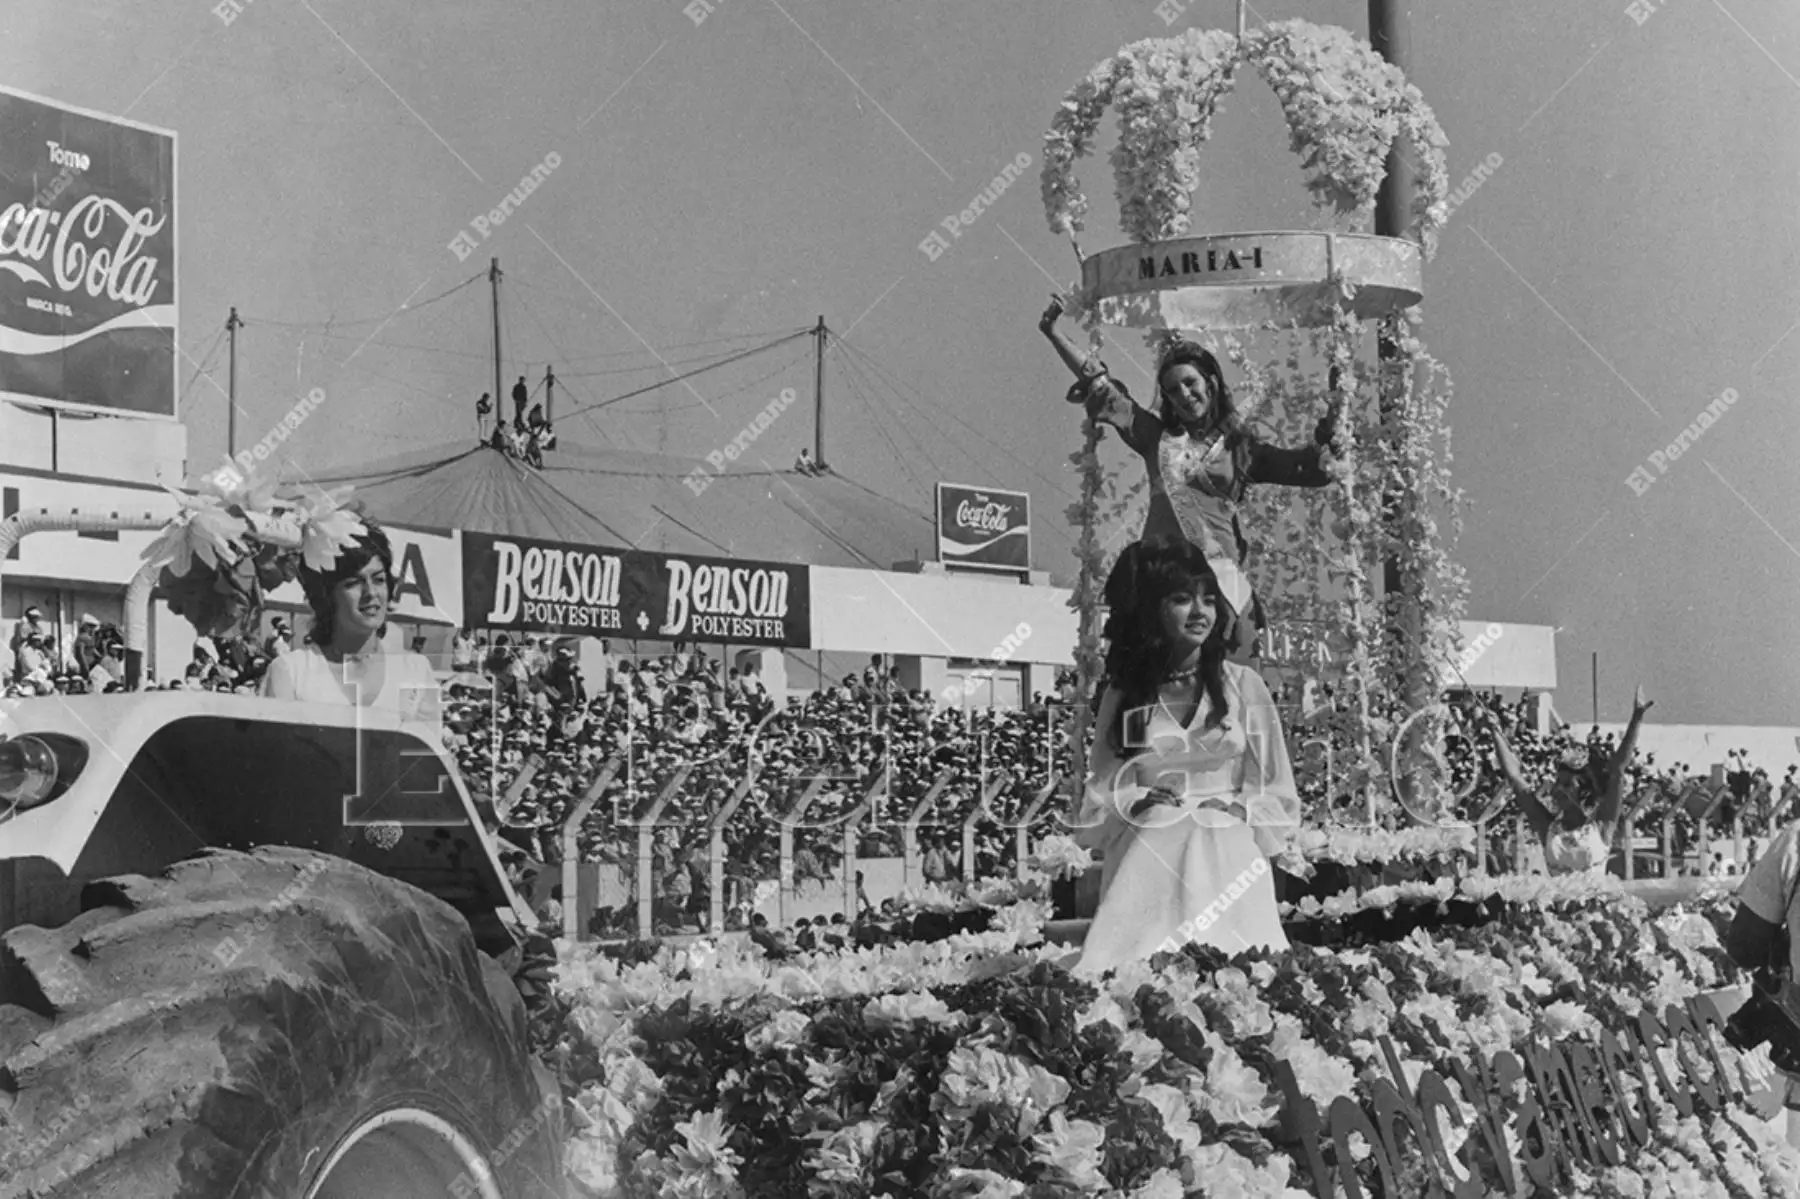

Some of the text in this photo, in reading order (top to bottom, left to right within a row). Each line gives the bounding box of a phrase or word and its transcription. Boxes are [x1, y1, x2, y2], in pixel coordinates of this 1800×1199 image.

[488, 541, 622, 623] Benson
[660, 559, 788, 635] Benson
[523, 601, 622, 629] POLYESTER
[692, 614, 785, 639] POLYESTER
